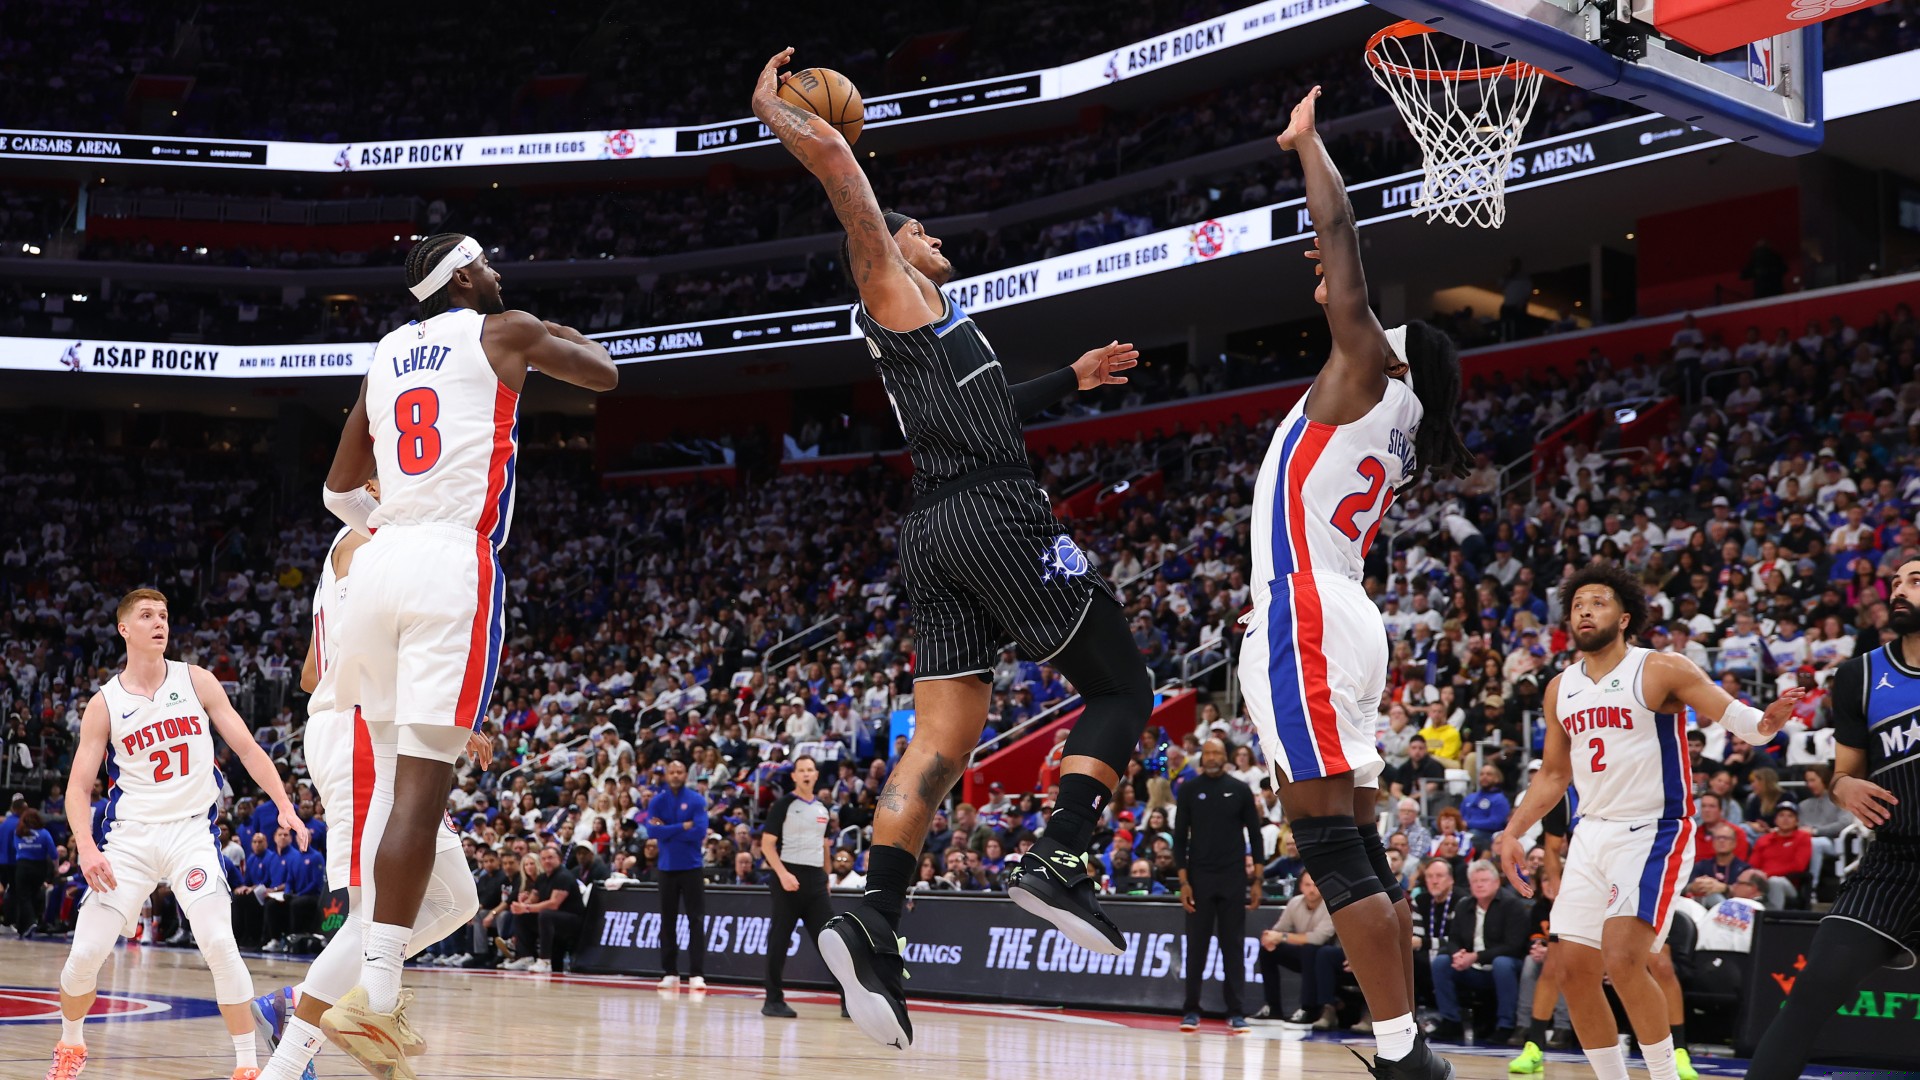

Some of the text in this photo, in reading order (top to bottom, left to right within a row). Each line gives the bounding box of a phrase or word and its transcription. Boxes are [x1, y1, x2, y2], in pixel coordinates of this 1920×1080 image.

[1173, 22, 1226, 57] ROCKY
[864, 102, 902, 121] ARENA
[11, 137, 73, 154] CAESARS
[76, 140, 121, 155] ARENA
[409, 143, 464, 163] ROCKY
[519, 143, 551, 155] ALTER
[556, 141, 585, 153] EGOS
[697, 129, 727, 150] JULY
[729, 127, 738, 143] 8
[1531, 142, 1596, 174] ARENA
[984, 269, 1039, 304] ROCKY
[1096, 252, 1131, 274] ALTER
[1136, 243, 1168, 265] EGOS
[600, 330, 703, 356] CAESARS ARENA
[152, 349, 219, 371] ROCKY
[239, 357, 258, 368] AND
[260, 357, 276, 368] HIS
[280, 354, 317, 368] ALTER
[320, 353, 353, 366] EGOS
[393, 345, 451, 378] LeVERT
[394, 386, 442, 476] 8
[122, 715, 202, 756] PISTONS
[1563, 706, 1634, 737] PISTONS
[149, 742, 190, 783] 27
[1588, 737, 1607, 773] 2
[600, 911, 635, 947] THE
[708, 915, 734, 952] IS
[733, 916, 804, 956] YOUS
[986, 926, 1036, 969] THE
[1141, 932, 1175, 977] IS
